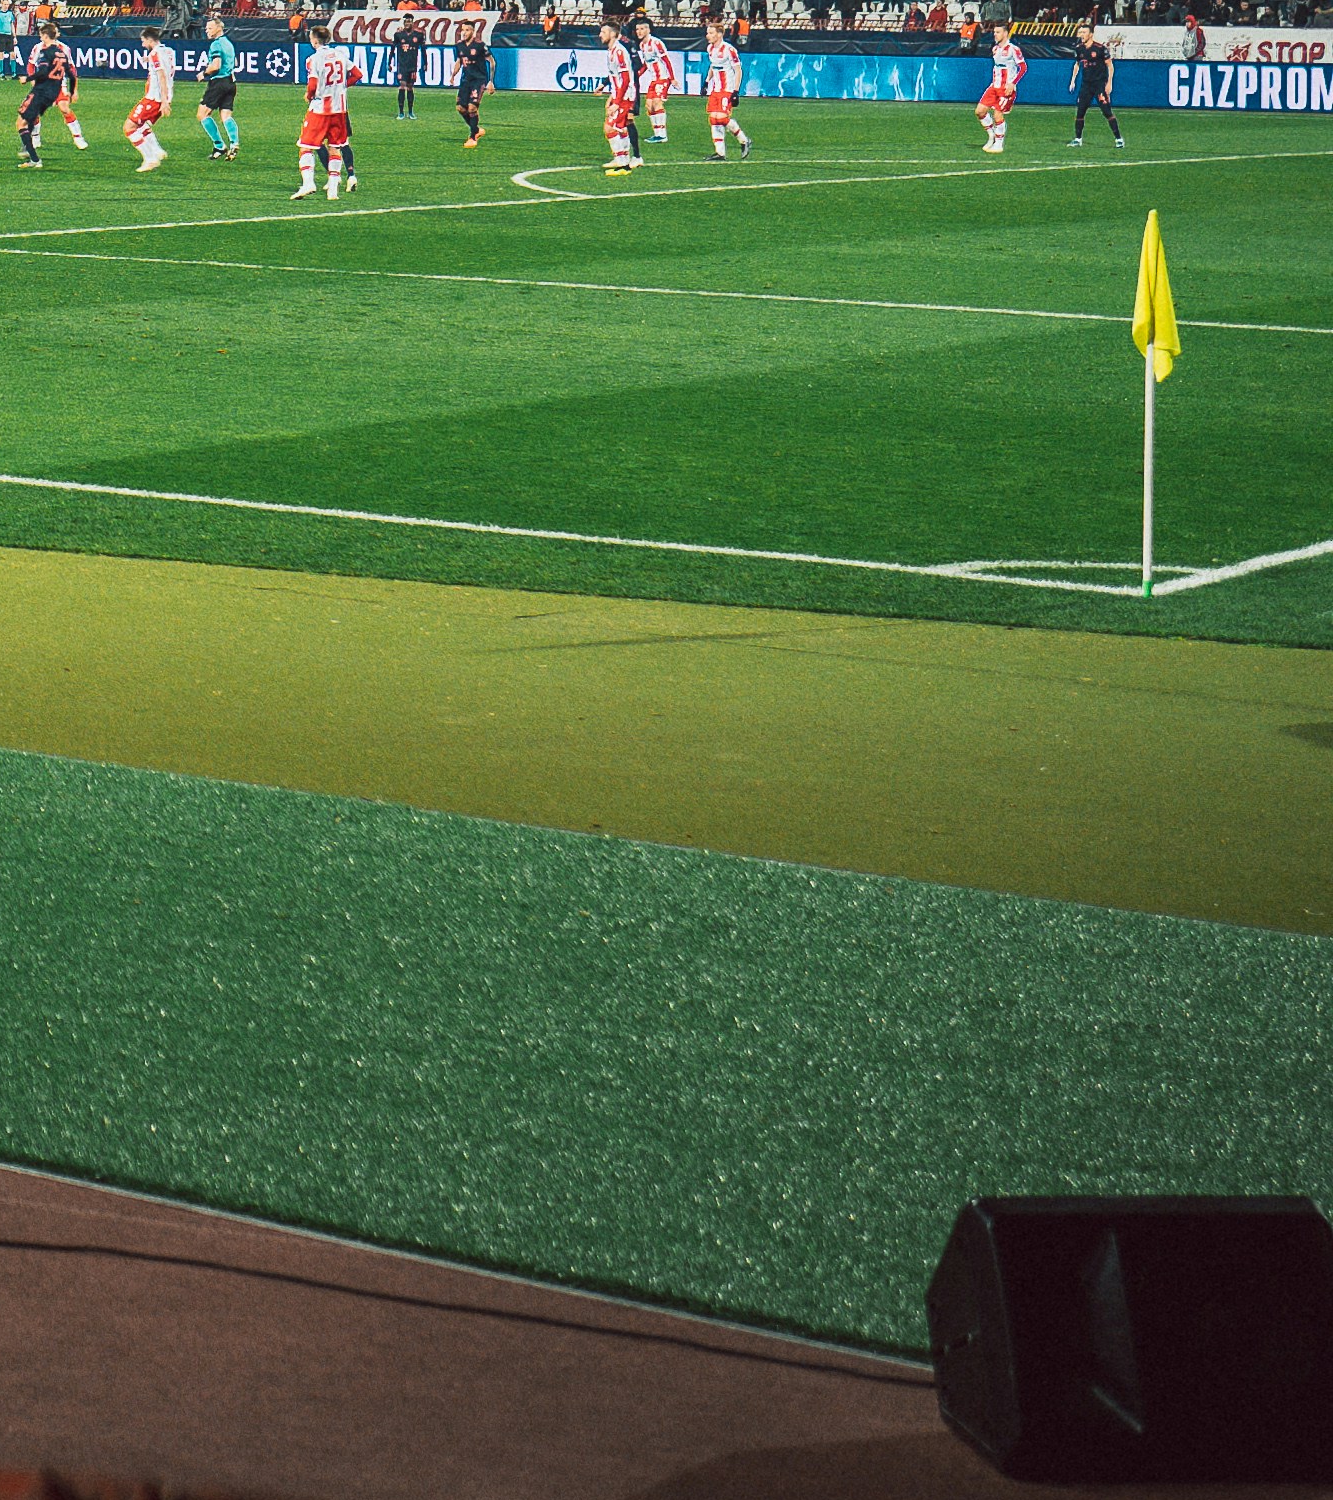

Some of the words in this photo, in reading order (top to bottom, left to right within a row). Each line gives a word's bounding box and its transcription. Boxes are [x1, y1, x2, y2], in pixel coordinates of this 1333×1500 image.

[174, 50, 260, 74] LEAUE
[1256, 40, 1326, 64] STOP
[324, 60, 344, 86] 23
[1168, 63, 1333, 111] GAZPROM
